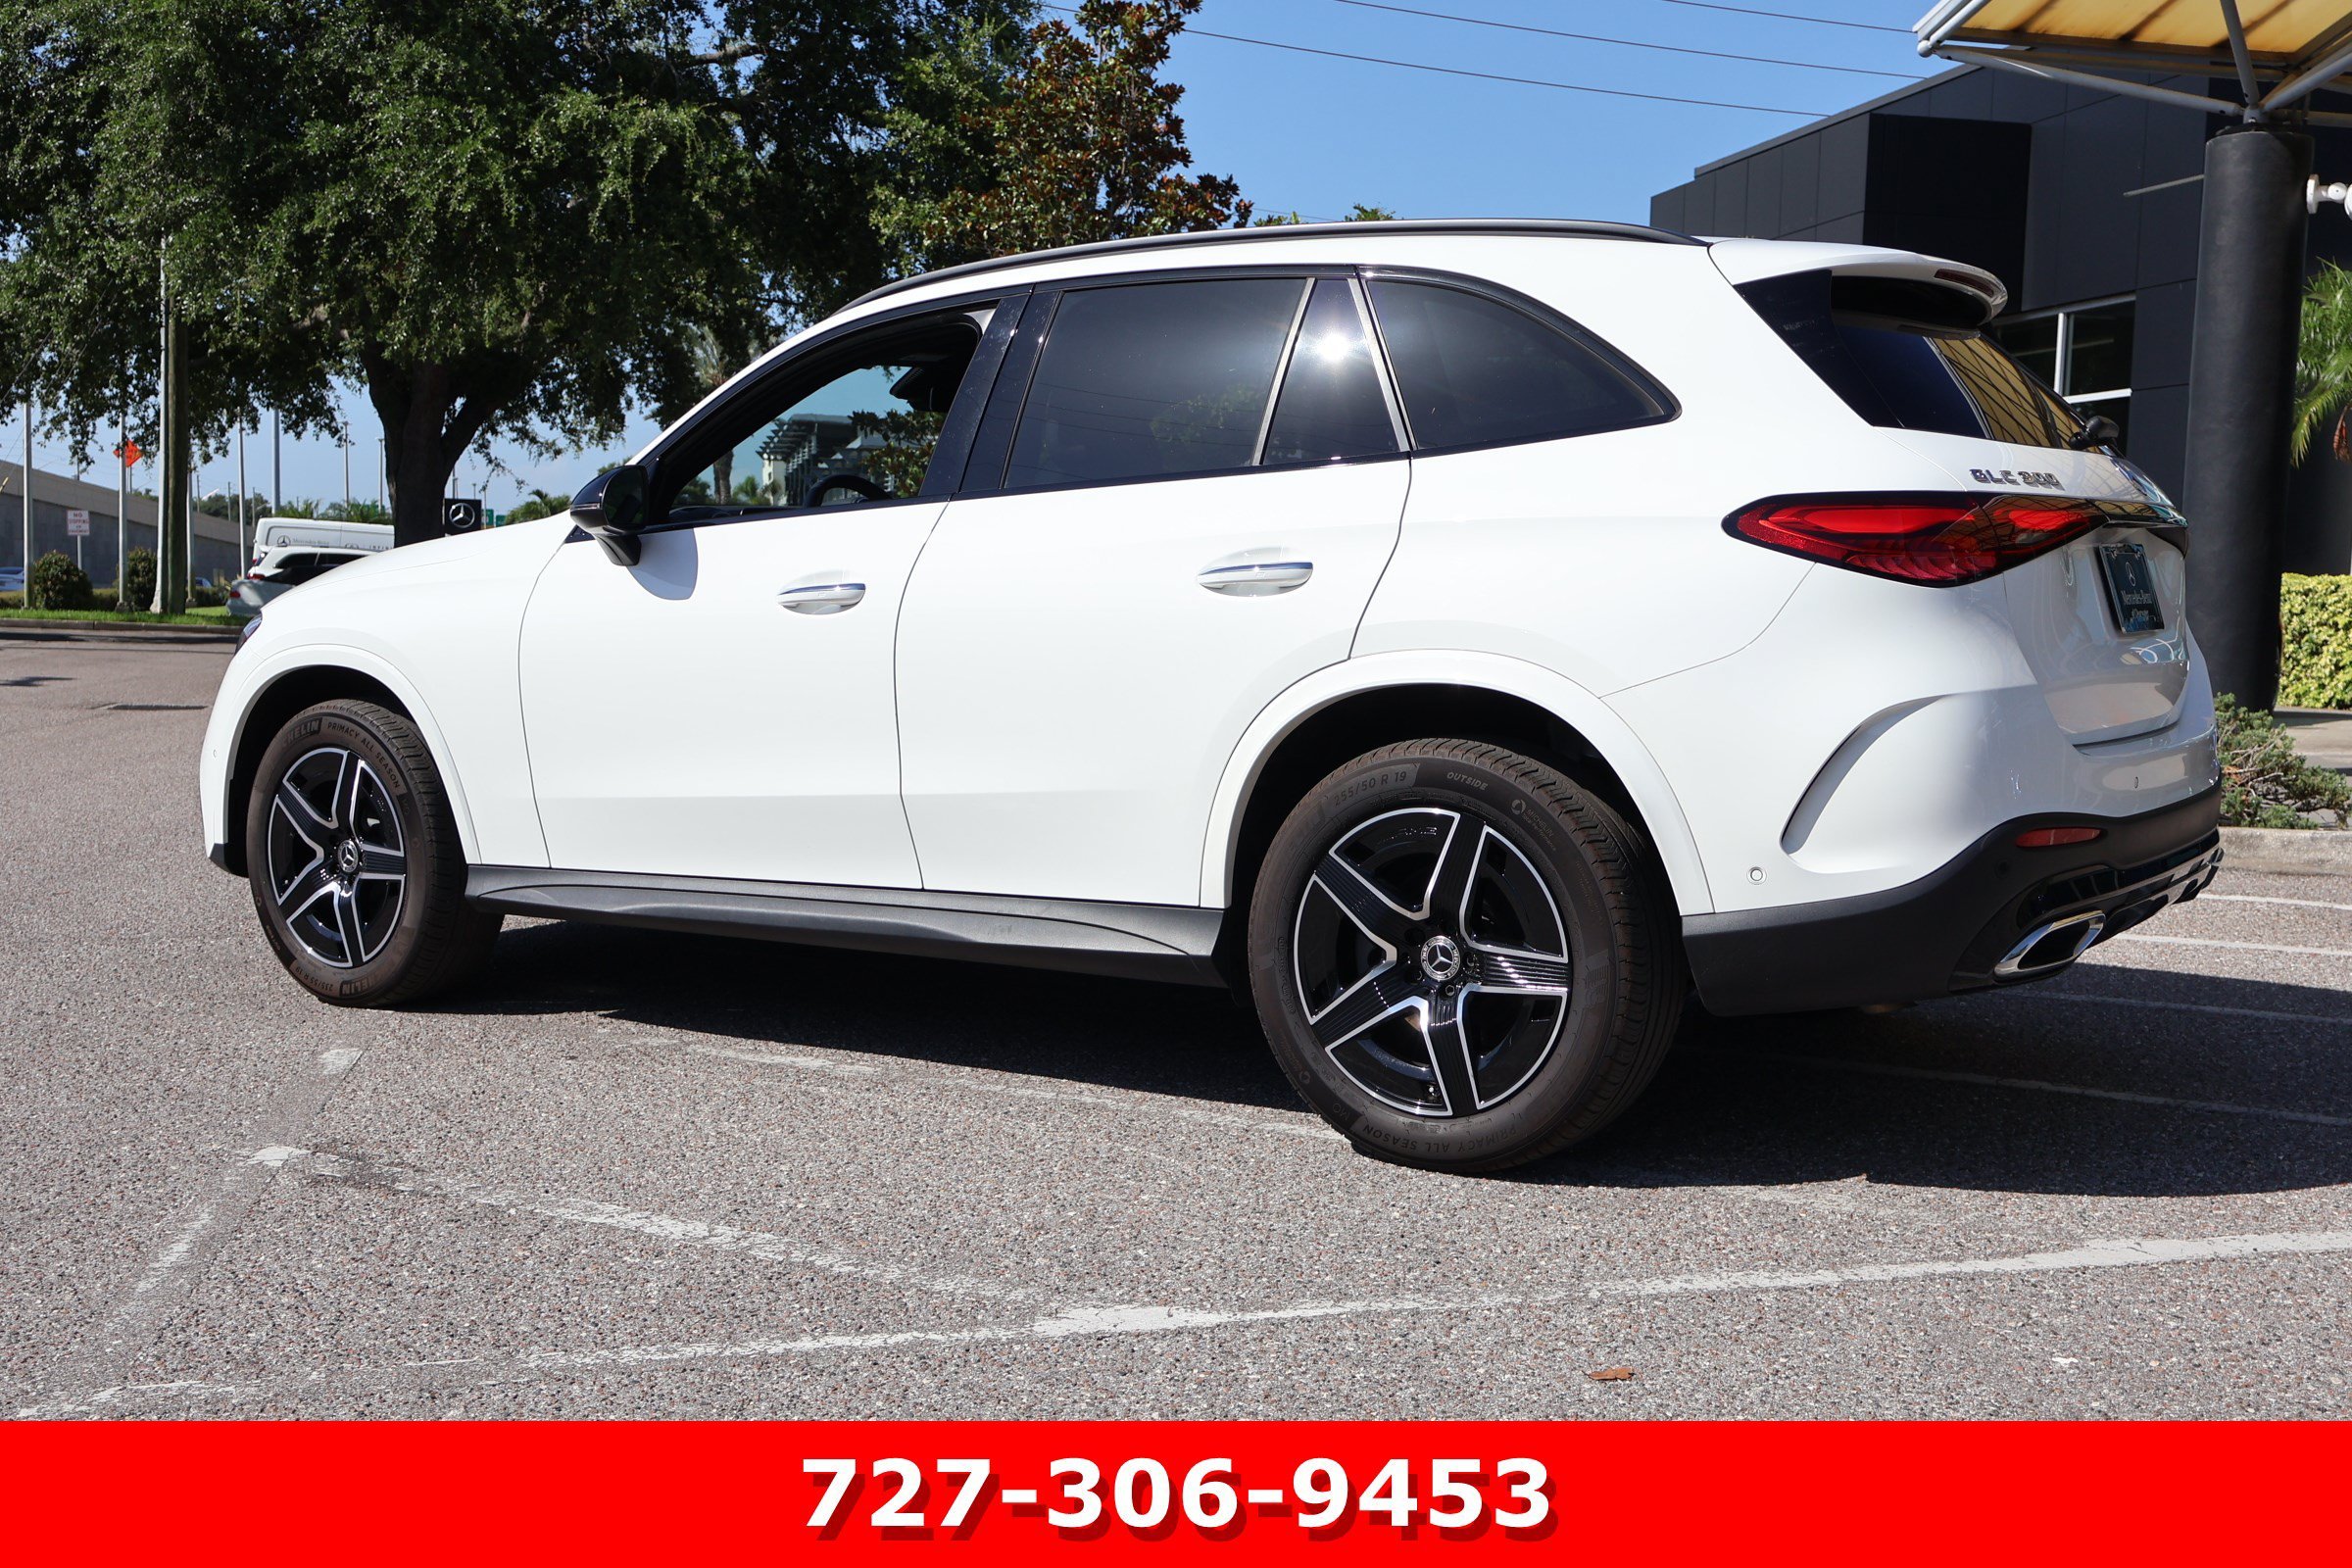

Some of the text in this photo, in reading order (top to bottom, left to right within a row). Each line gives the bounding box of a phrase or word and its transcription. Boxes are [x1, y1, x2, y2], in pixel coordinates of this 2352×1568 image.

[1969, 468, 2066, 491] GLC 300
[327, 721, 401, 789] PRIMACY ALL SEASON
[1334, 777, 1376, 807] 255/50
[1381, 773, 1389, 785] R
[1395, 770, 1407, 783] 19
[1446, 771, 1489, 791] OUTSIDE
[1363, 1125, 1517, 1154] PRIMACY ALL SEASON
